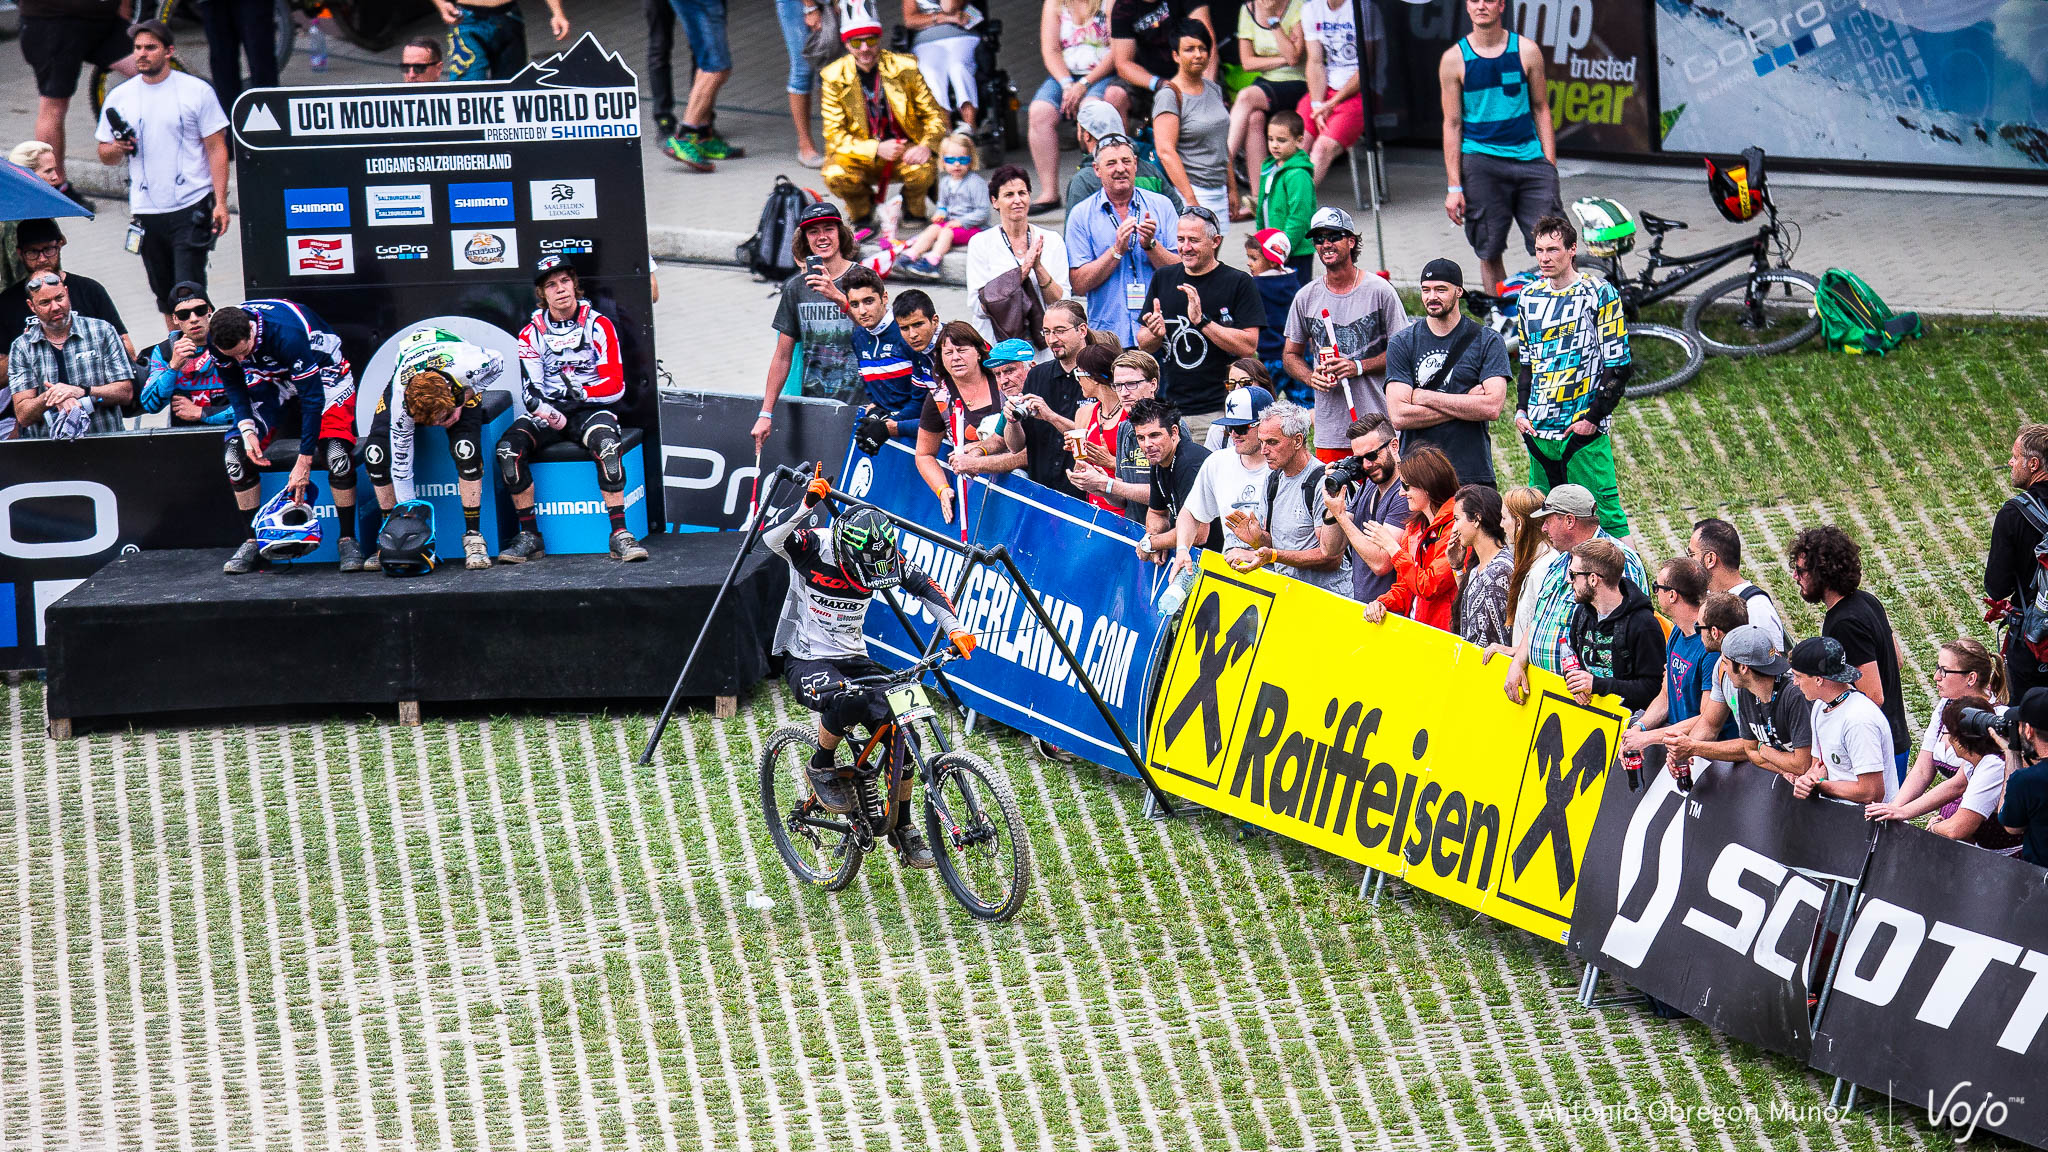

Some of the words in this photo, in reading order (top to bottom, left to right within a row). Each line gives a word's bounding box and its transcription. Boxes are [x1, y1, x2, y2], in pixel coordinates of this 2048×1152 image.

[1684, 1, 1826, 84] GoPro
[1568, 54, 1637, 82] trusted
[297, 102, 334, 131] UCI
[340, 98, 451, 129] MOUNTAIN
[457, 96, 506, 126] BIKE
[512, 93, 589, 123] WORLD
[594, 91, 637, 121] CUP
[1546, 78, 1634, 131] gear
[487, 128, 535, 141] PRESENTED
[537, 126, 547, 139] BY
[552, 123, 638, 139] SHIMANO
[366, 157, 415, 174] LEOGANG
[416, 153, 512, 172] SALZBURGERLAND
[290, 203, 344, 213] SHIMANO
[454, 197, 509, 208] SHIMANO
[376, 245, 428, 255] GoPro
[539, 239, 593, 249] GoPro
[817, 597, 859, 612] MAXXIS
[904, 688, 919, 708] 2
[1230, 682, 1500, 891] Raiffeisen
[1689, 800, 1702, 819] TM
[1681, 842, 2048, 1055] SCOTT
